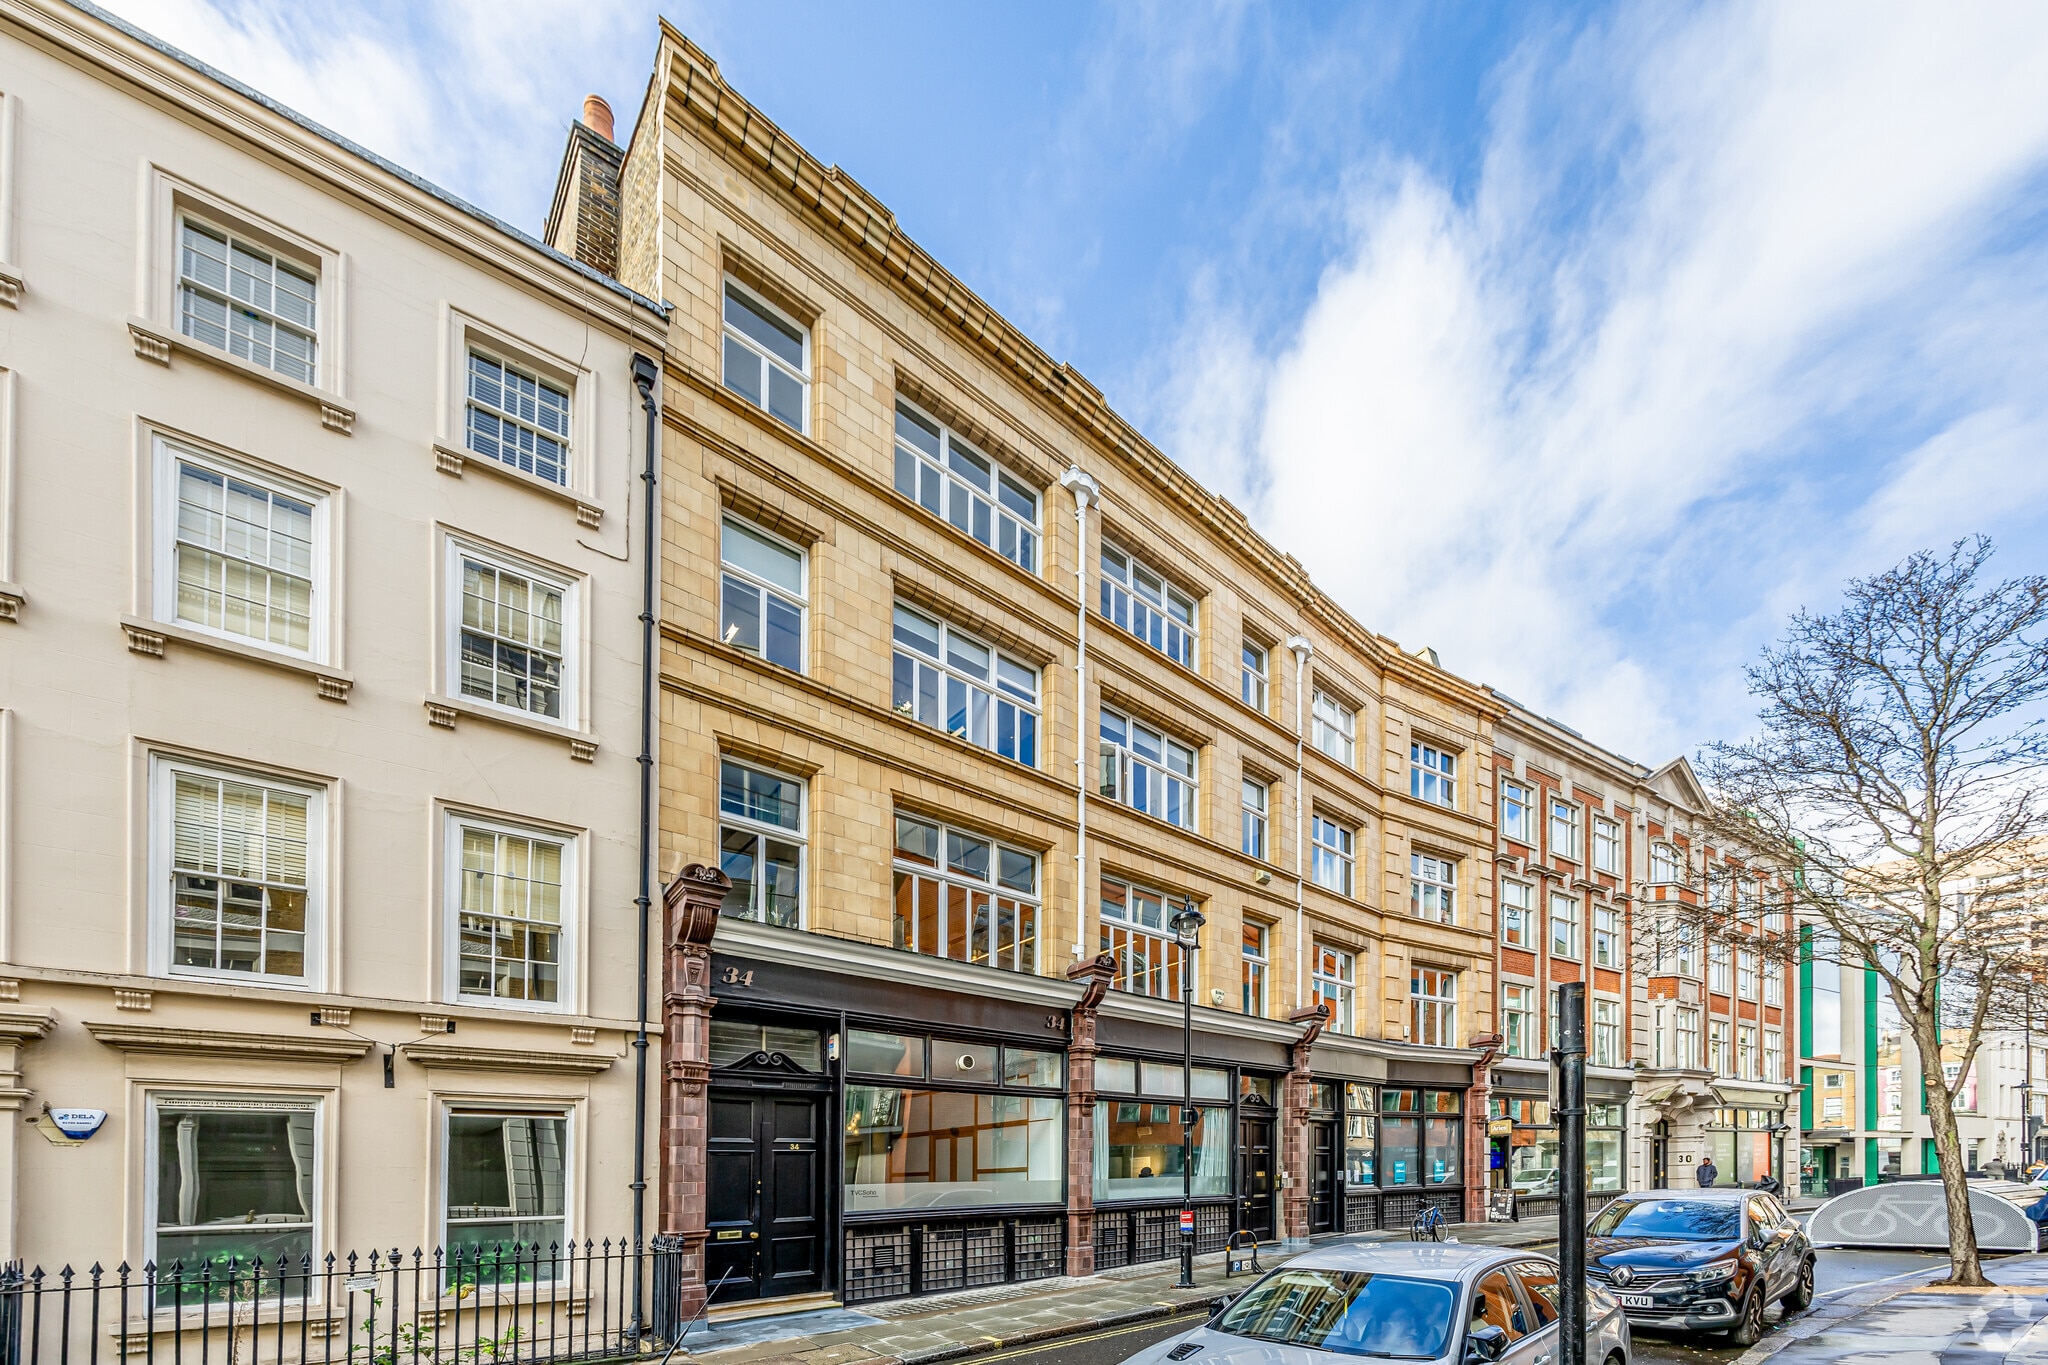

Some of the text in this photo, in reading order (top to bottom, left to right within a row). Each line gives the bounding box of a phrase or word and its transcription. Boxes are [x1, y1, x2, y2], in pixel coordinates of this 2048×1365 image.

[722, 966, 754, 987] 34
[1045, 1015, 1066, 1031] 34
[790, 1143, 800, 1151] 34
[1678, 1154, 1692, 1163] 30
[1625, 1296, 1648, 1306] KVU
